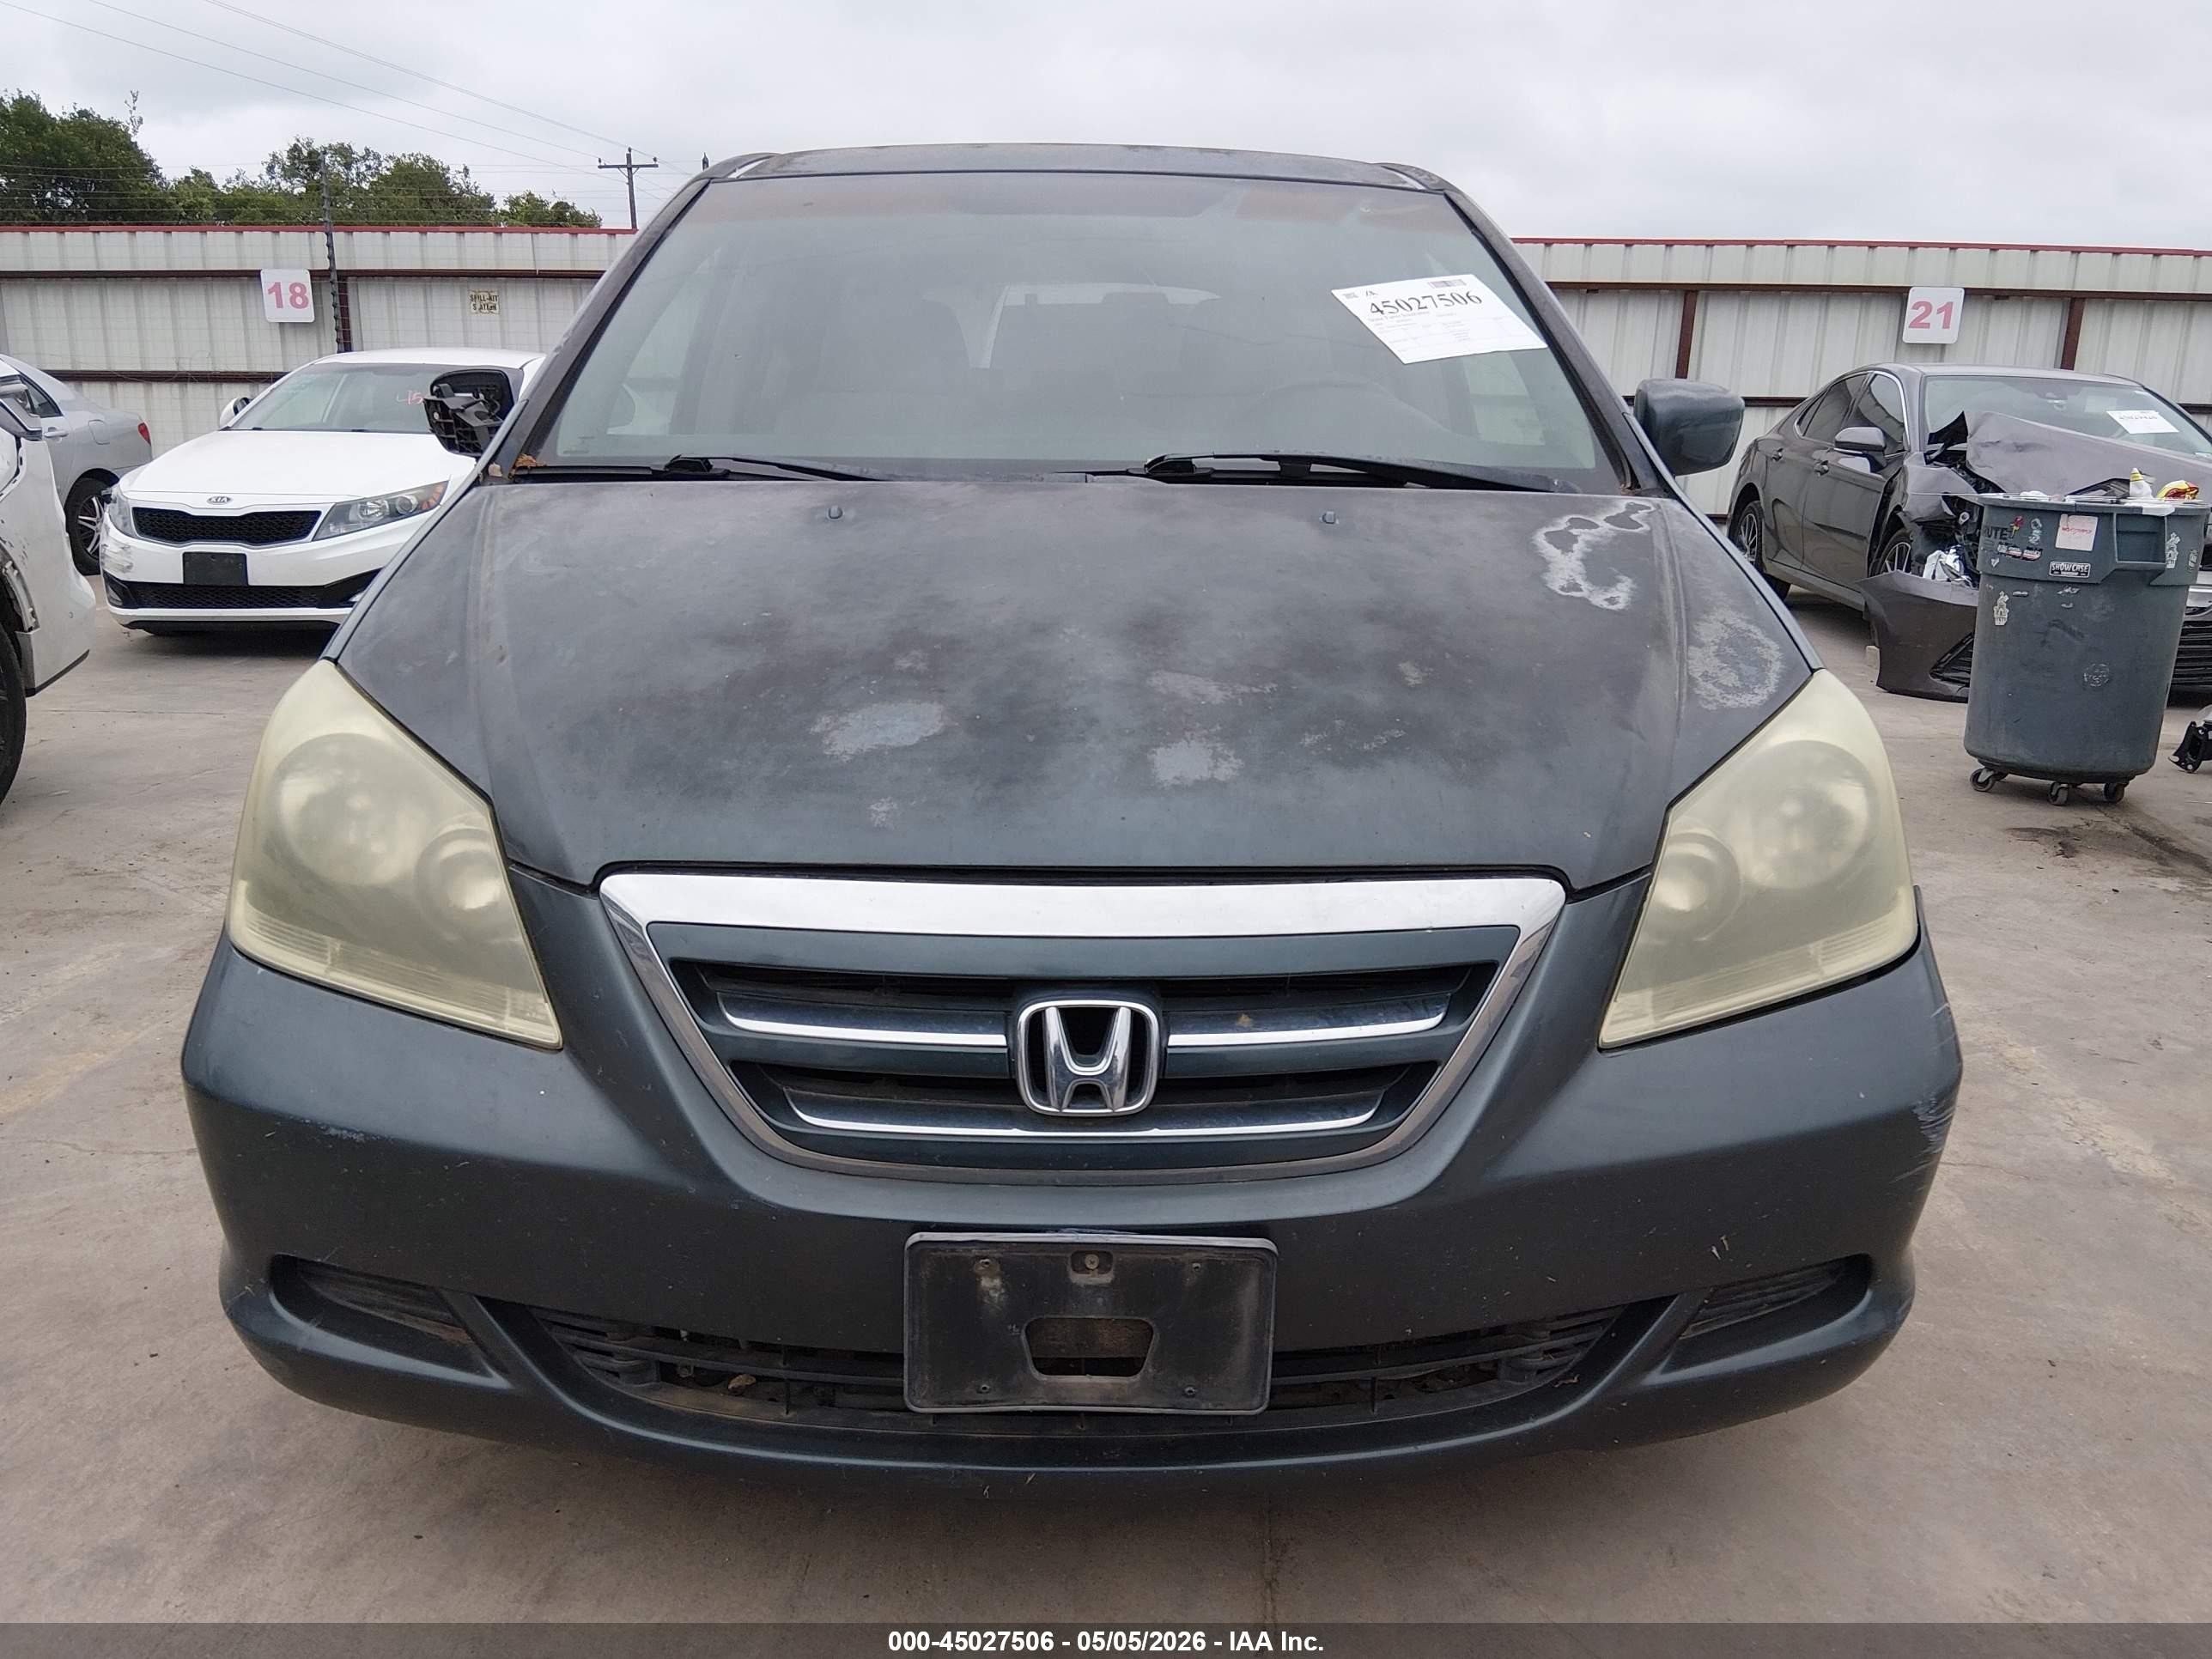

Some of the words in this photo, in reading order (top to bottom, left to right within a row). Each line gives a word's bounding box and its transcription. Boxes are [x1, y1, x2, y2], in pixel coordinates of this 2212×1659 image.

[268, 282, 309, 309] 18
[1370, 290, 1483, 315] 45027506
[1909, 301, 1954, 330] 21
[2051, 562, 2089, 573] SHOWCASE
